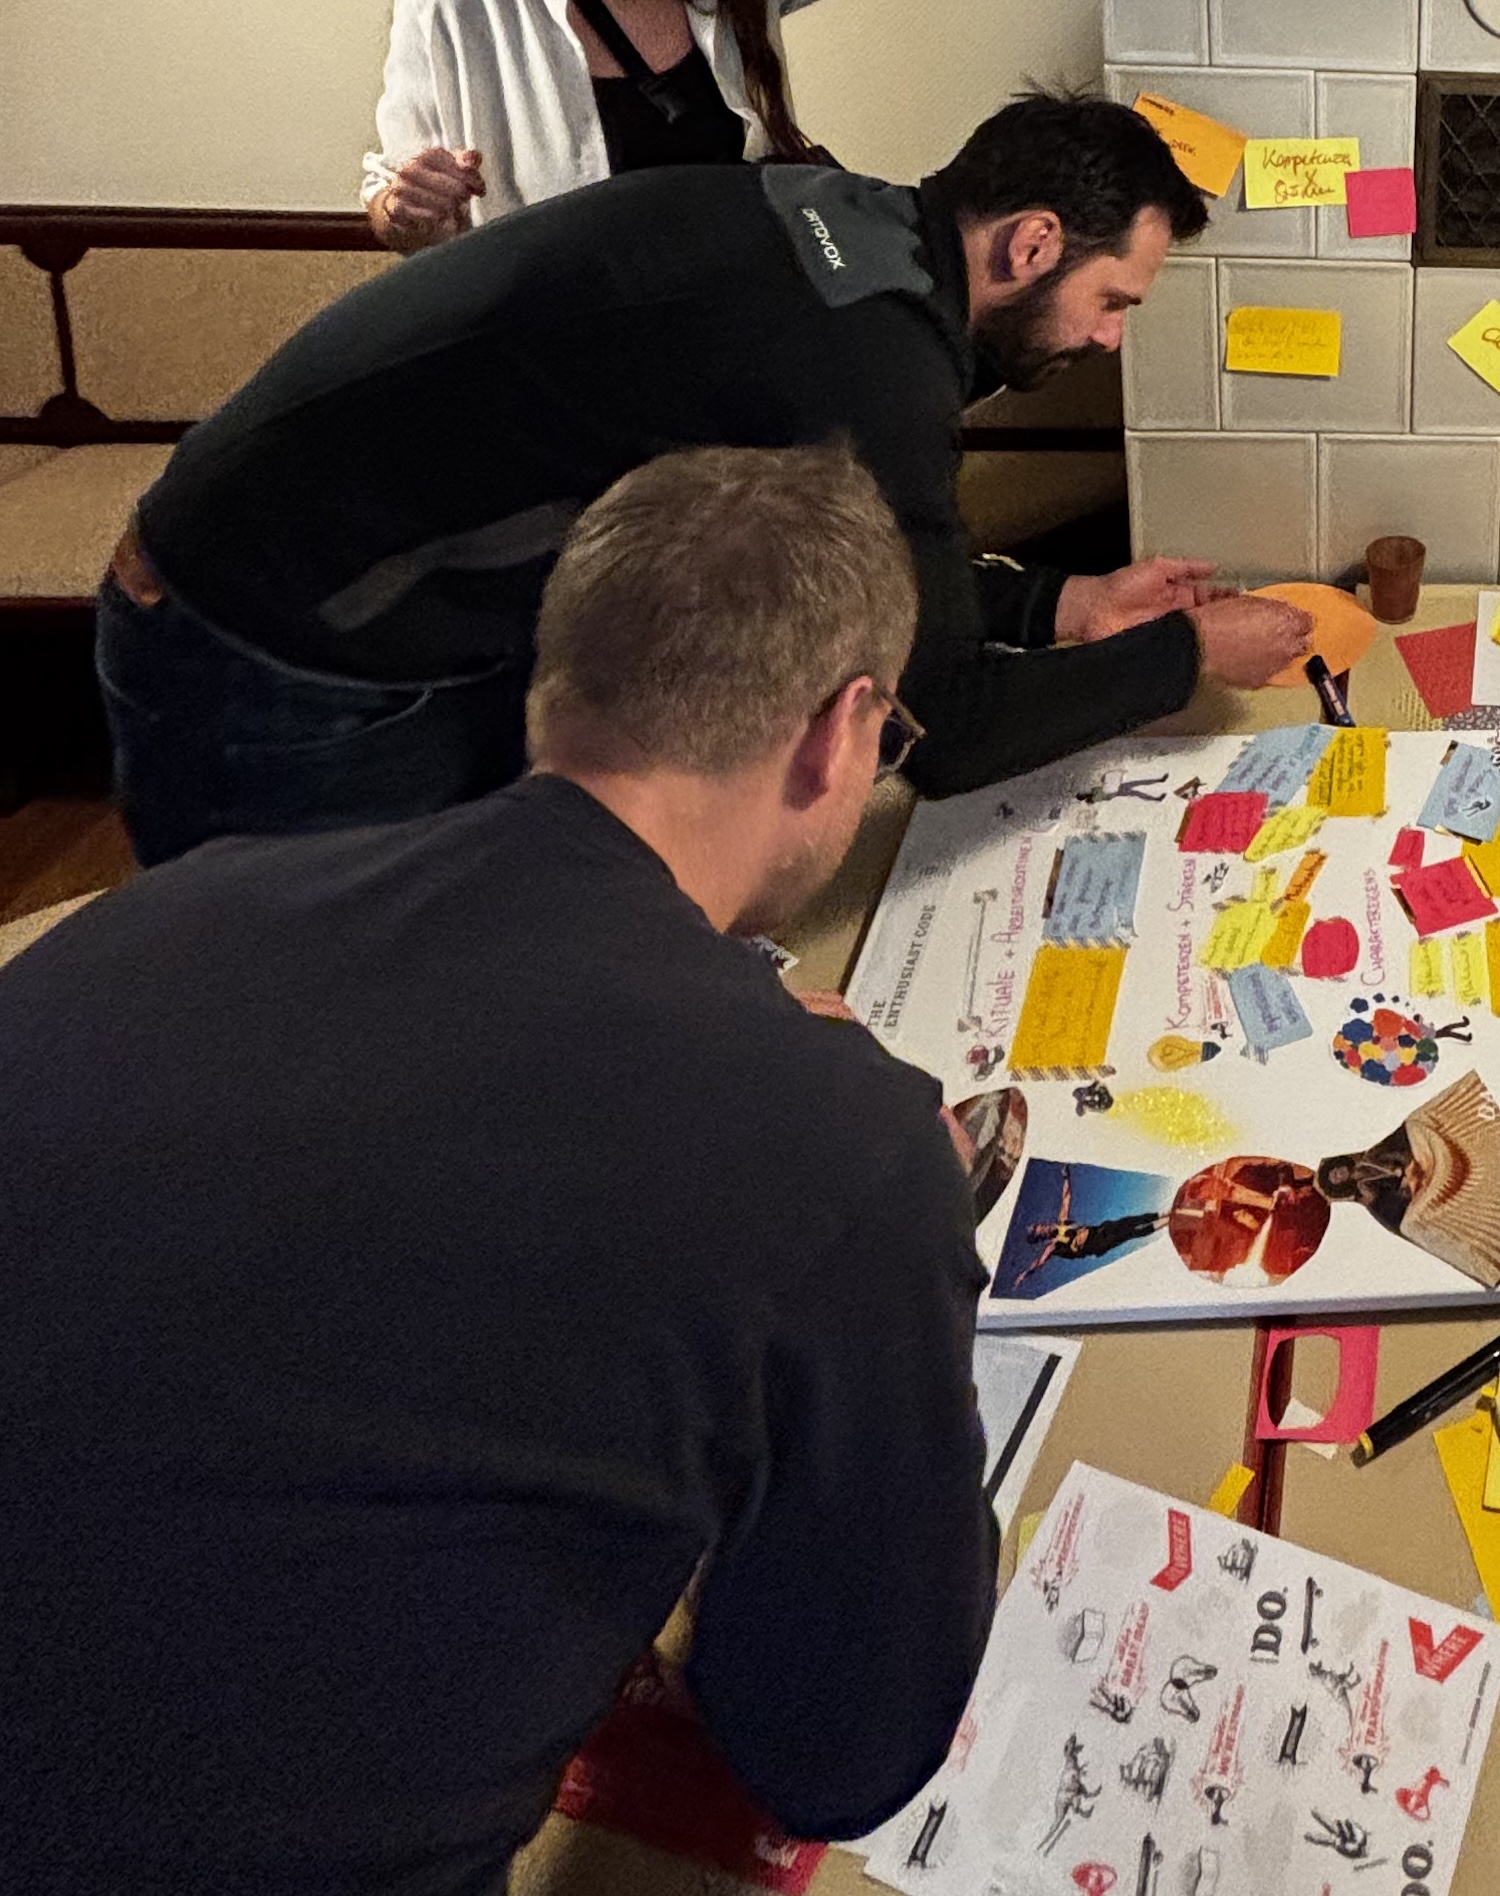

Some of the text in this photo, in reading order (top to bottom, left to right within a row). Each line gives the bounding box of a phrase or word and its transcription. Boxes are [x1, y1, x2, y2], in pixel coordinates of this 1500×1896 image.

[801, 206, 847, 271] ORTOVOX
[882, 903, 937, 1028] ENTHUSIAST CODE
